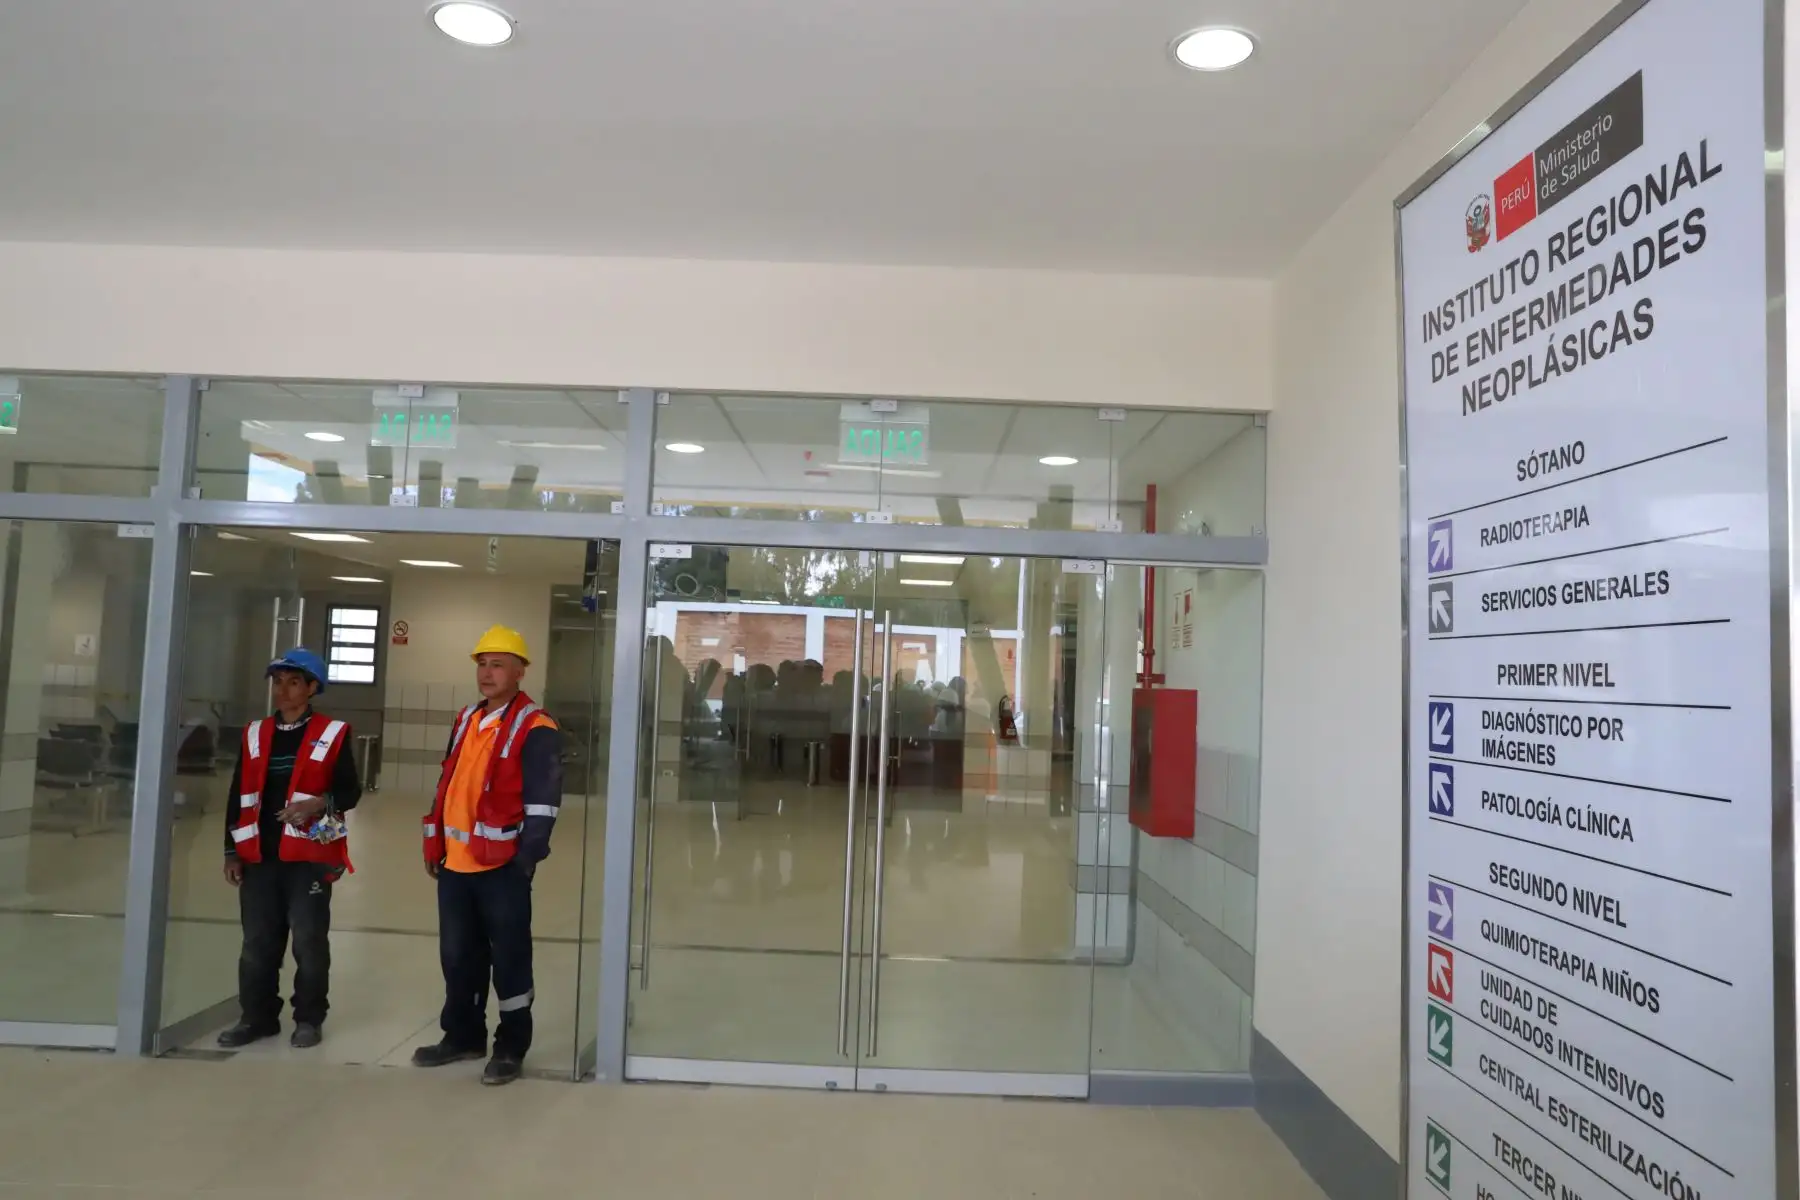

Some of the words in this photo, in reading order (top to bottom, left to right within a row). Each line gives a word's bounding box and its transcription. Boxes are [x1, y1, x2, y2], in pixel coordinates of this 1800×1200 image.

[1539, 114, 1613, 178] Ministerio
[1541, 177, 1558, 200] de
[1561, 144, 1600, 187] Salud
[1501, 177, 1531, 216] PERÚ
[1423, 249, 1540, 343] INSTITUTO
[1547, 138, 1723, 272] REGIONAL
[1432, 341, 1459, 383] DE
[1466, 207, 1707, 367] ENFERMEDADES
[1461, 298, 1655, 417] NEOPLÁSICAS
[1516, 440, 1585, 482] SÓTANO
[1480, 504, 1590, 547] RADIOTERAPIA
[1481, 585, 1557, 612] SERVICIOS
[1561, 569, 1670, 605] GENERALES
[1497, 663, 1558, 687] PRIMER
[1563, 662, 1616, 688] NIVEL
[1481, 708, 1583, 738] DIAGNÓSTICO
[1587, 718, 1624, 741] POR
[1481, 734, 1556, 766] IMÁGENES
[1481, 789, 1562, 826] PATOLOGÍA
[1566, 800, 1634, 842] CLÍNICA
[1489, 862, 1568, 907] SEGUNDO
[1573, 887, 1627, 929] NIVEL
[1480, 919, 1598, 986] QUIMIOTERAPIA
[1602, 966, 1660, 1014] NIÑOS
[1480, 969, 1533, 1012] UNIDAD
[1537, 1000, 1558, 1026] DE
[1480, 1000, 1554, 1055] CUIDADOS
[1558, 1039, 1665, 1120] INTENSIVOS
[1479, 1054, 1544, 1113] CENTRAL
[1548, 1095, 1700, 1200] ESTERILIZACIÓN
[1492, 1132, 1556, 1197] TERCER
